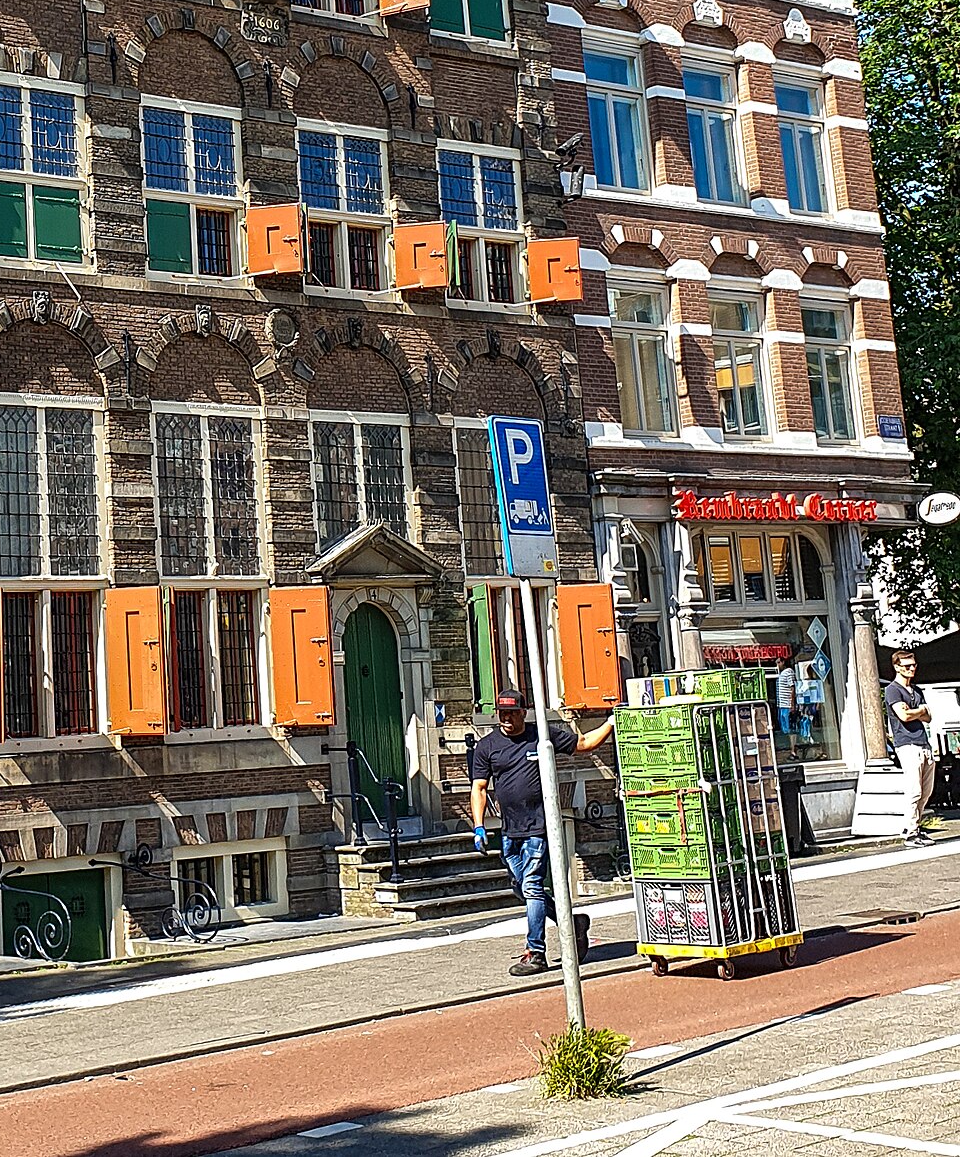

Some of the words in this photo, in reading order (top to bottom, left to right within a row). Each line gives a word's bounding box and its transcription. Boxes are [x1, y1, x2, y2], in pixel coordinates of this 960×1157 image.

[254, 16, 280, 30] 1606
[505, 428, 534, 485] P
[673, 490, 798, 520] Rembrandt
[803, 493, 879, 522] Corner
